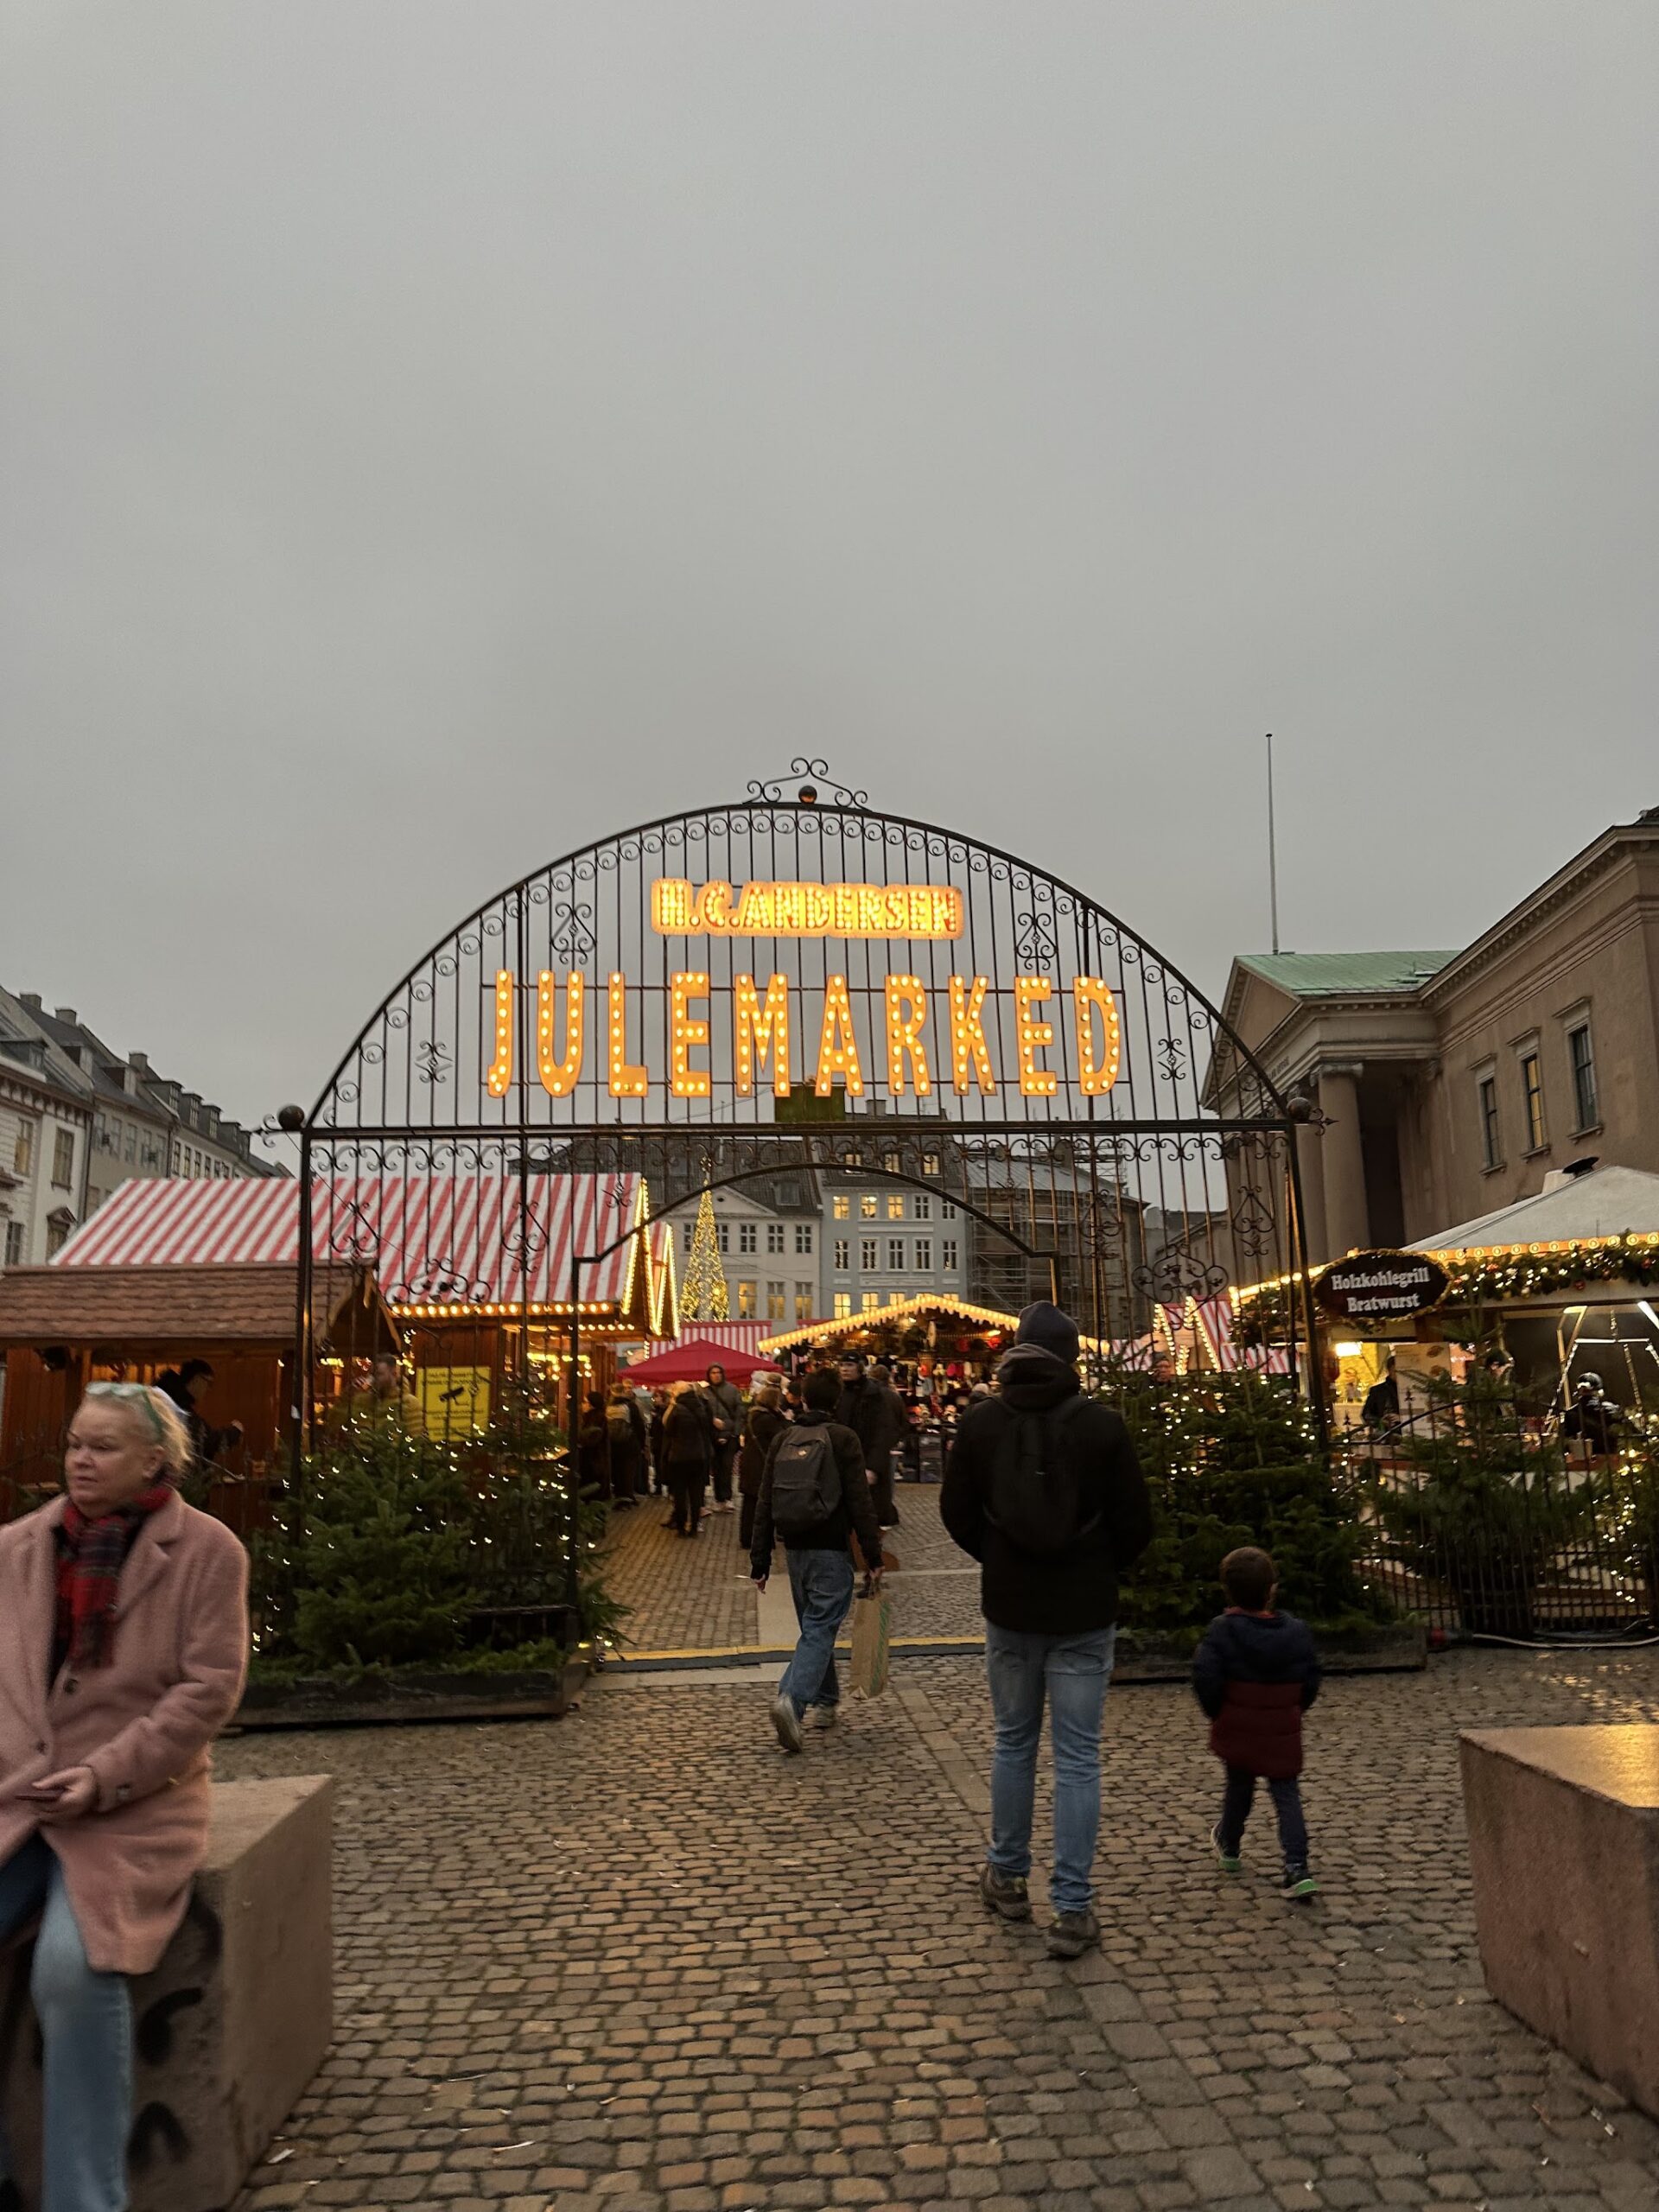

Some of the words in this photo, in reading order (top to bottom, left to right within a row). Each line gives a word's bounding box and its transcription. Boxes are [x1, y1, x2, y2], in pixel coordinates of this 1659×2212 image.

[488, 969, 1121, 1097] JULEMARKED
[1332, 1267, 1431, 1290] Holzkohlegrill
[1347, 1294, 1421, 1313] Bratwurst
